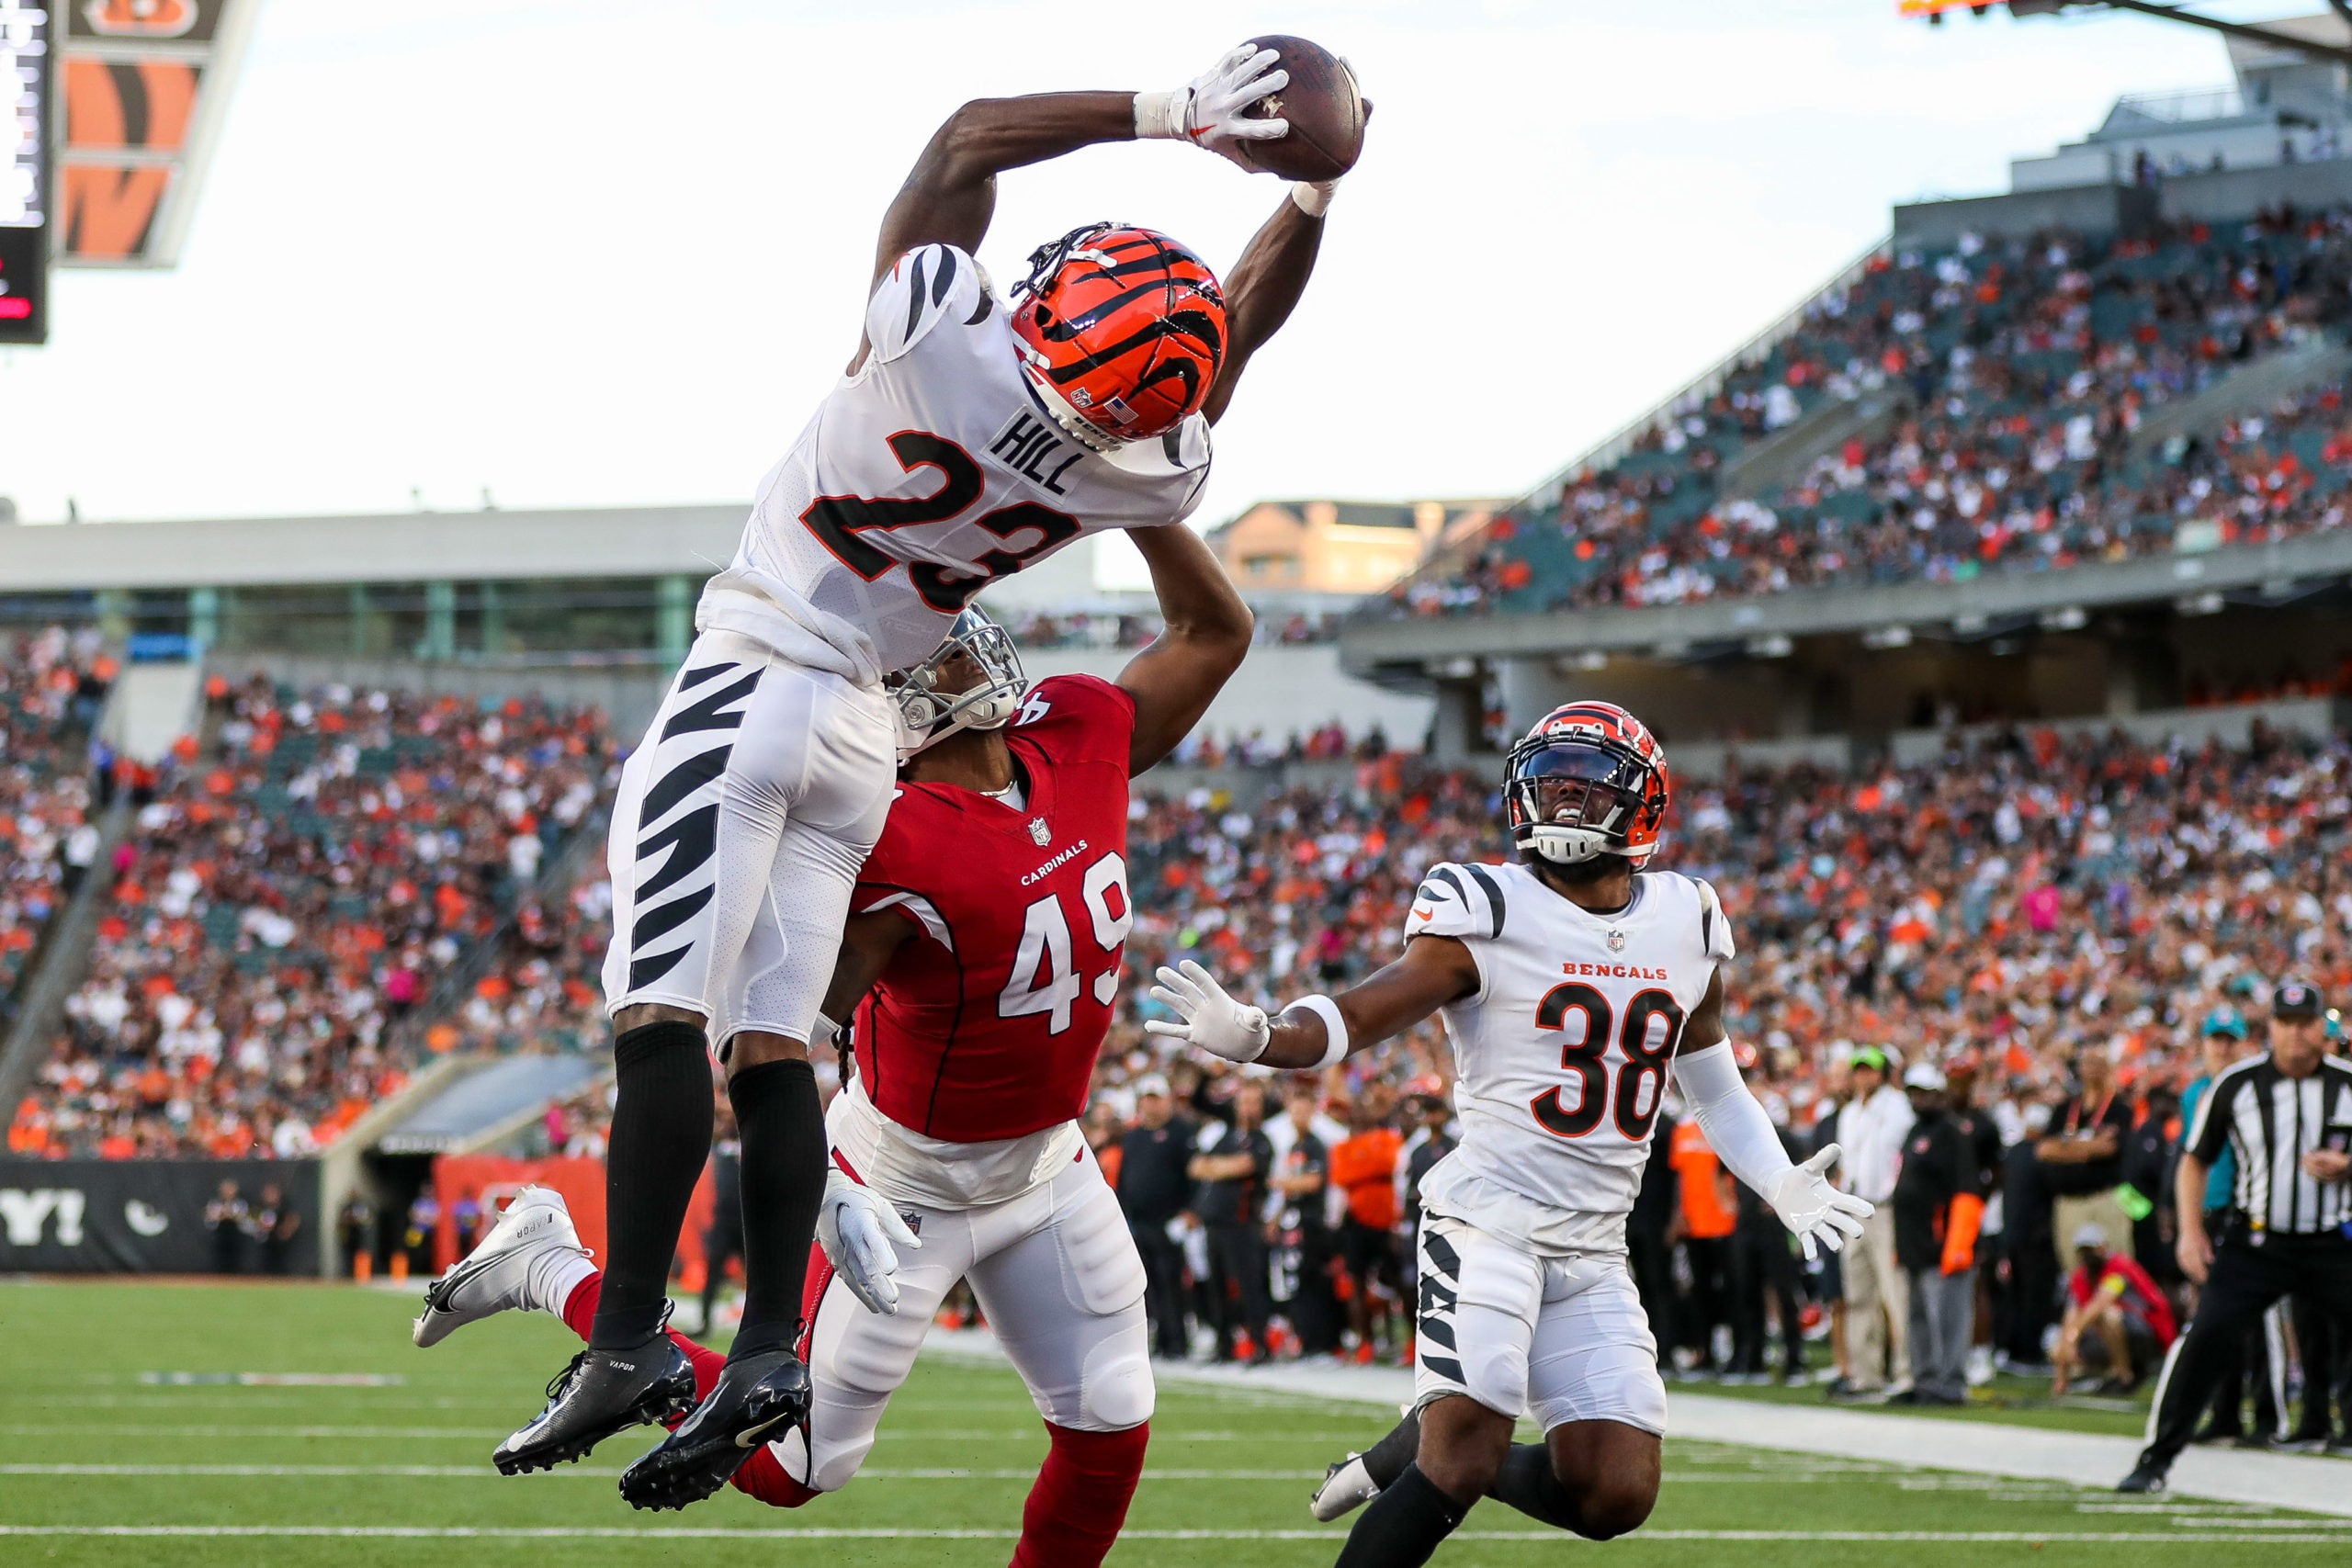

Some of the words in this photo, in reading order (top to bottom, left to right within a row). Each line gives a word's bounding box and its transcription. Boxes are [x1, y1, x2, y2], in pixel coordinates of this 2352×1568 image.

[989, 412, 1084, 495] HILL
[798, 429, 1081, 614] 23
[1014, 691, 1052, 727] 4
[1021, 840, 1088, 886] CARDINALS
[999, 850, 1134, 1036] 49
[1563, 963, 1668, 980] BENGALS
[1530, 981, 1684, 1142] 38
[516, 1213, 553, 1238] APOR
[609, 1359, 636, 1371] VAPOR
